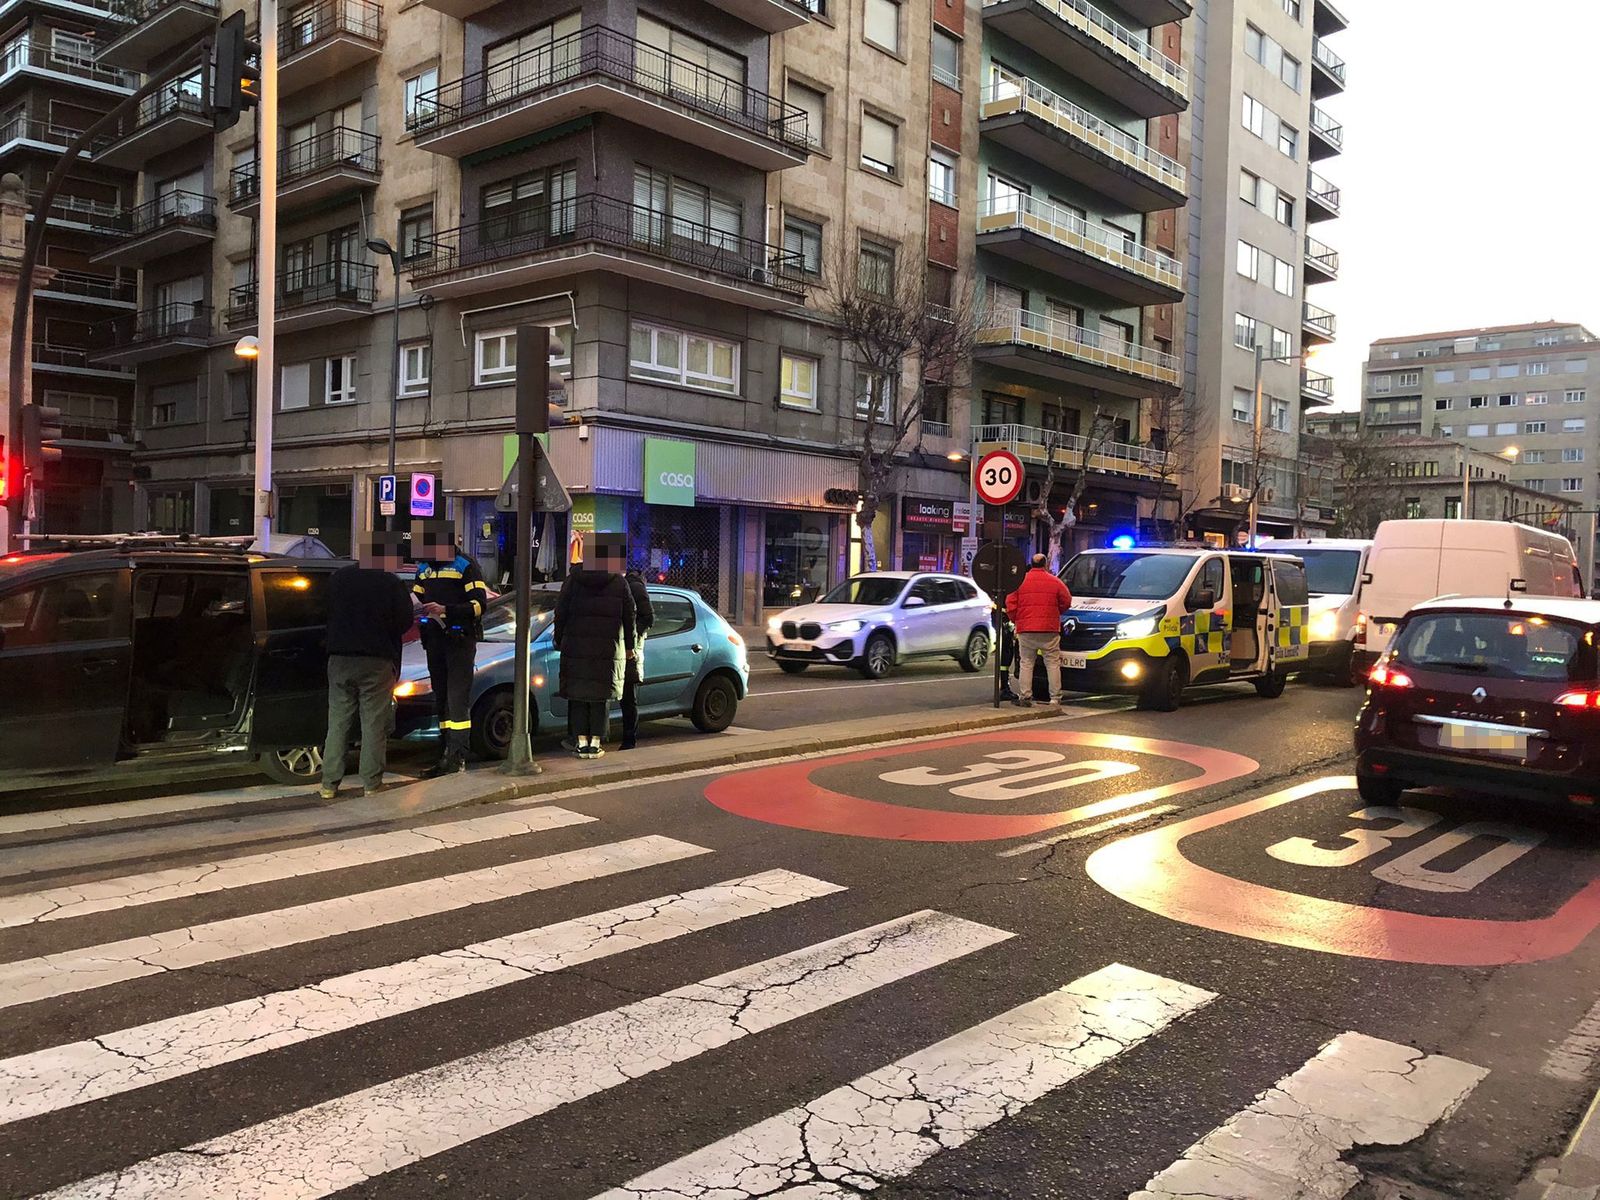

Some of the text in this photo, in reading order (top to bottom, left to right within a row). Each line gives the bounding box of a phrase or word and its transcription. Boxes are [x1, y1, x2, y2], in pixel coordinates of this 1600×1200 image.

[660, 472, 694, 488] casa
[985, 467, 1012, 486] 30
[382, 480, 392, 501] P
[572, 512, 594, 523] casa
[402, 531, 412, 540] cas
[1070, 658, 1085, 668] LRC
[878, 749, 1141, 801] 30
[1264, 805, 1549, 893] 30
